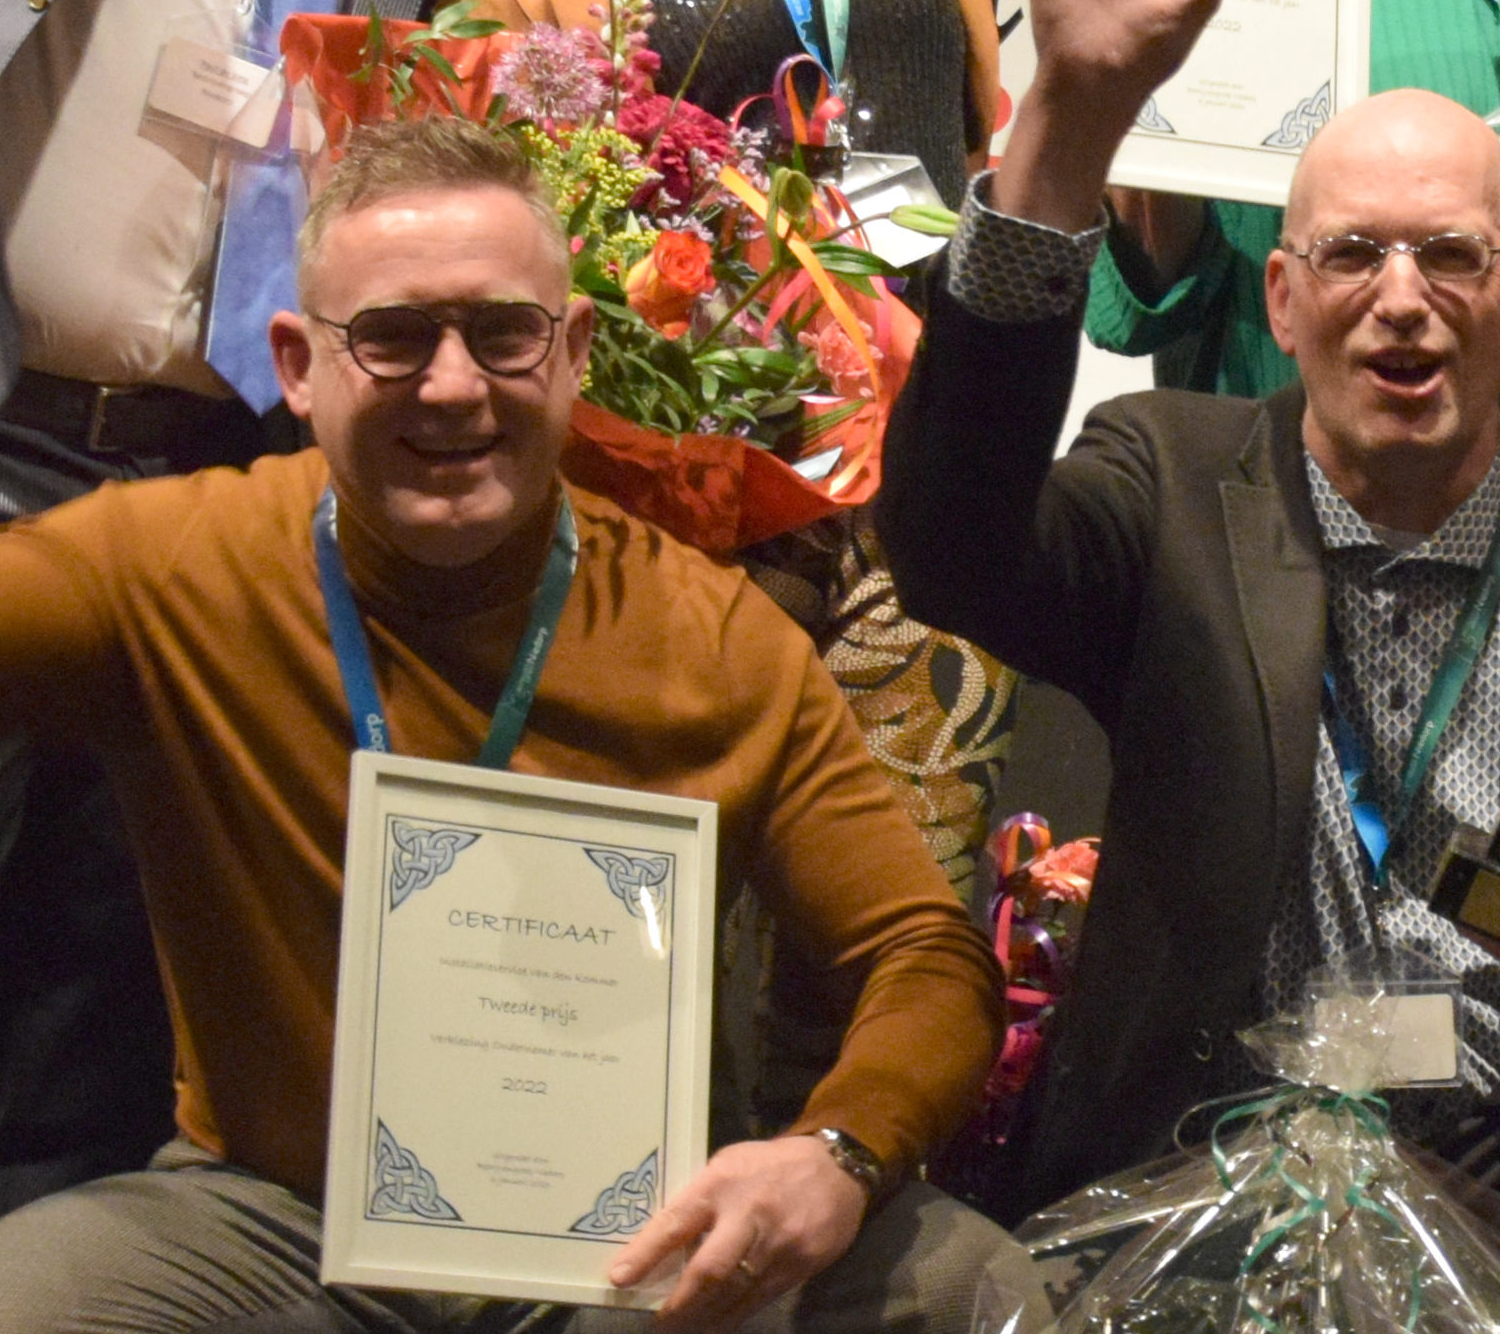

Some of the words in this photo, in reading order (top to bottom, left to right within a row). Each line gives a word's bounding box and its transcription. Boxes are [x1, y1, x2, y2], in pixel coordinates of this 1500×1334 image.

[448, 909, 617, 946] CERTIFICAAT
[477, 996, 536, 1017] Tweede
[540, 1002, 579, 1027] prijs
[501, 1077, 549, 1096] 2022
